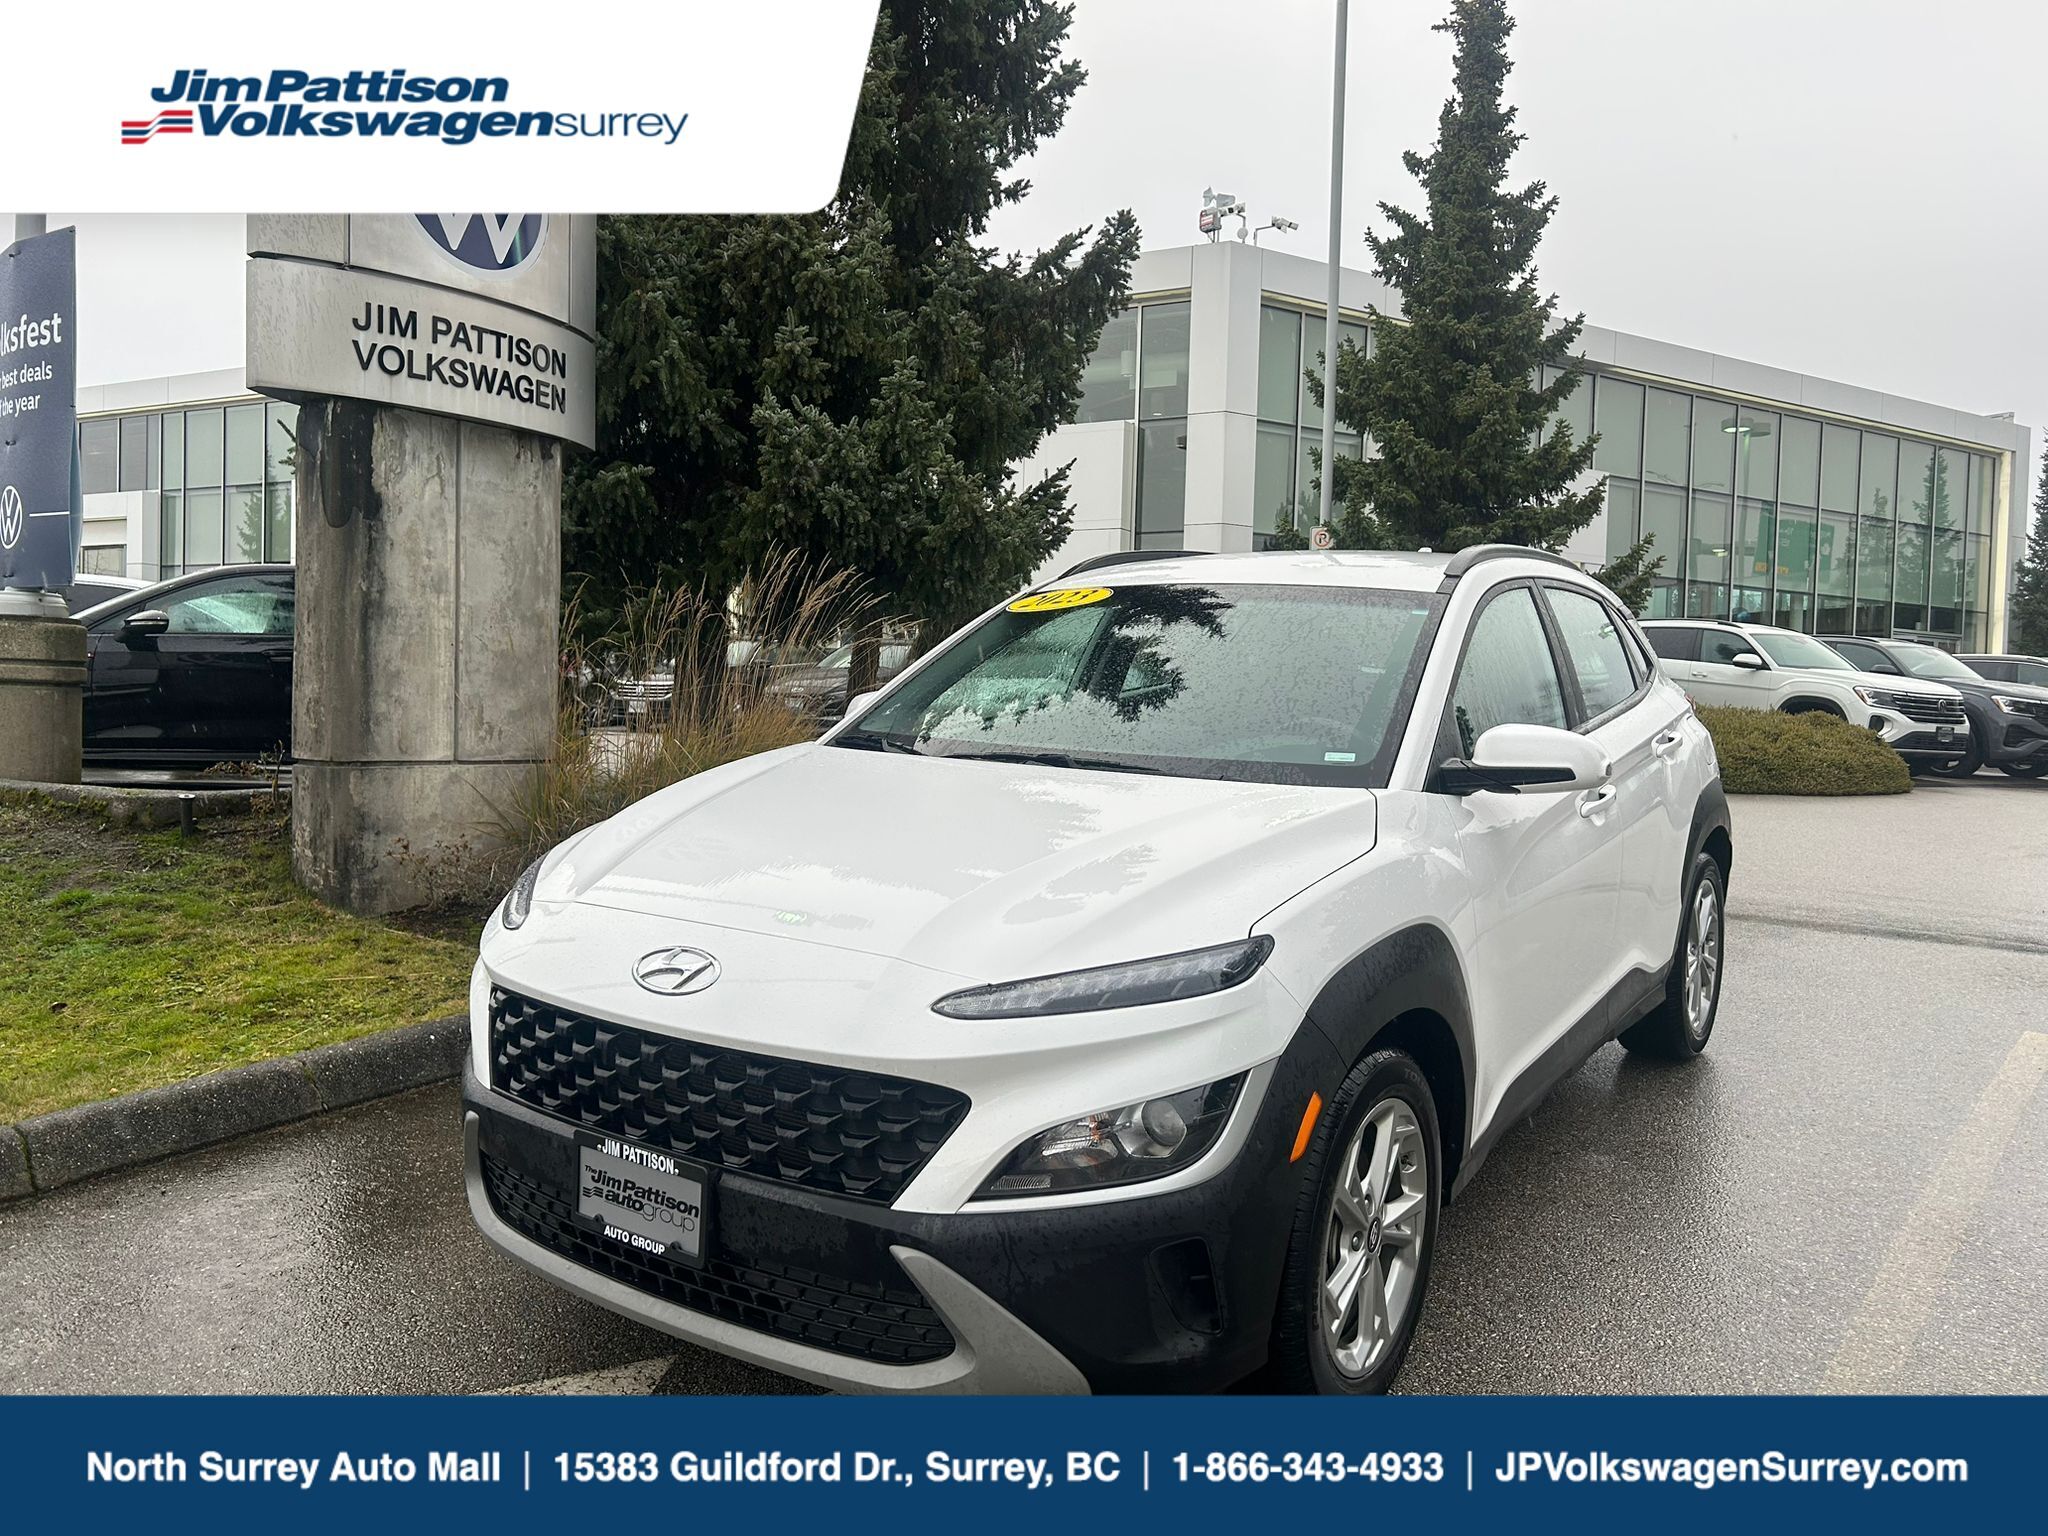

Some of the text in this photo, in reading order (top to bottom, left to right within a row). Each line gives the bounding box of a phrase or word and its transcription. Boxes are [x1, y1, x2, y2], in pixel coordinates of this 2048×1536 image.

[351, 301, 567, 380] JIM PATTISON
[1, 368, 18, 390] best
[20, 360, 53, 384] deals
[351, 339, 567, 415] VOLKSWAGEN
[2, 396, 13, 416] the
[14, 394, 41, 418] year
[584, 1164, 598, 1175] The
[602, 1138, 675, 1175] JIM PATTISON
[603, 1224, 666, 1256] AUTO GROUP
